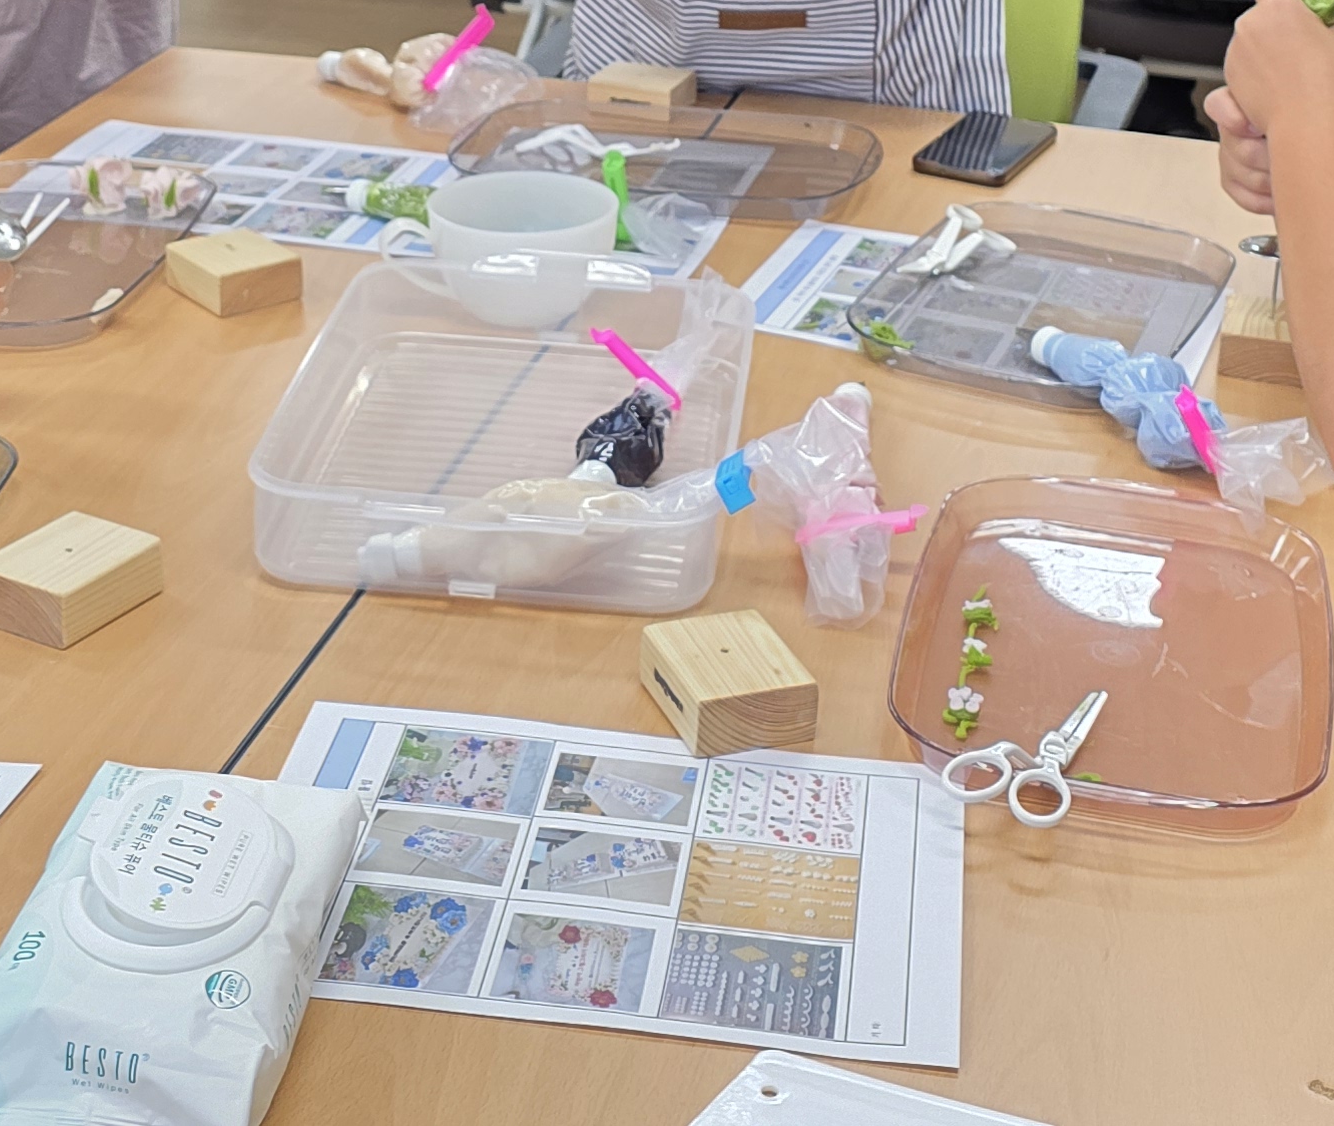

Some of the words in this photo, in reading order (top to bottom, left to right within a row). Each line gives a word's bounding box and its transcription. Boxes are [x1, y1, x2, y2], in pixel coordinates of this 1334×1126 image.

[131, 823, 158, 851] 물티슈
[153, 809, 223, 884] BESTO
[118, 853, 142, 875] 퓨어
[215, 871, 230, 894] WIPES
[65, 1041, 140, 1084] BESTO
